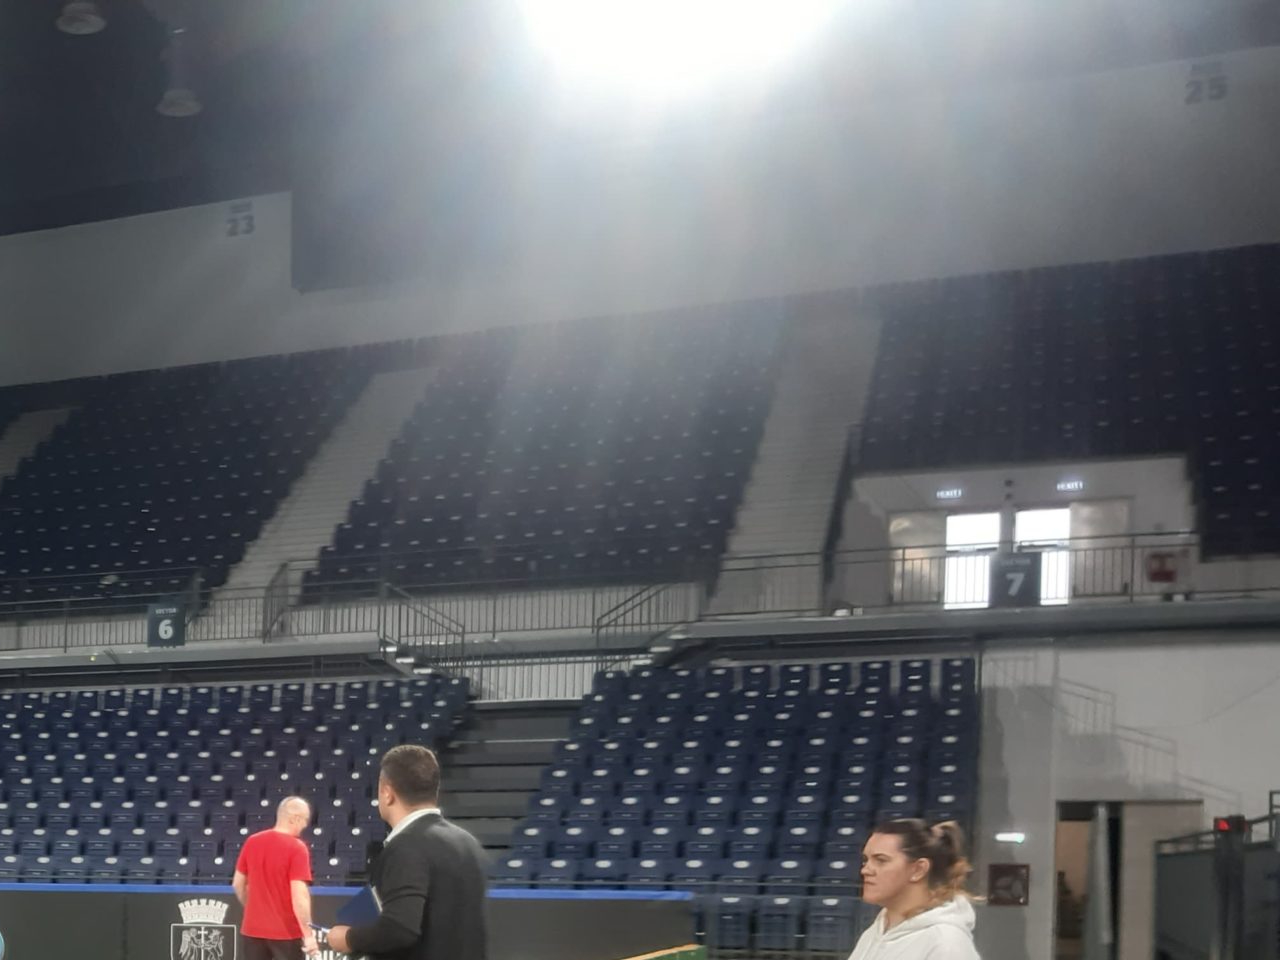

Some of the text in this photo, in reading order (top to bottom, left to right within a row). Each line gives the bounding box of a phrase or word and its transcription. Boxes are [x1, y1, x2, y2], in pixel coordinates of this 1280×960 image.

[1183, 75, 1228, 105] 25
[225, 214, 256, 237] 23
[1006, 572, 1025, 597] 7
[158, 619, 174, 640] 6
